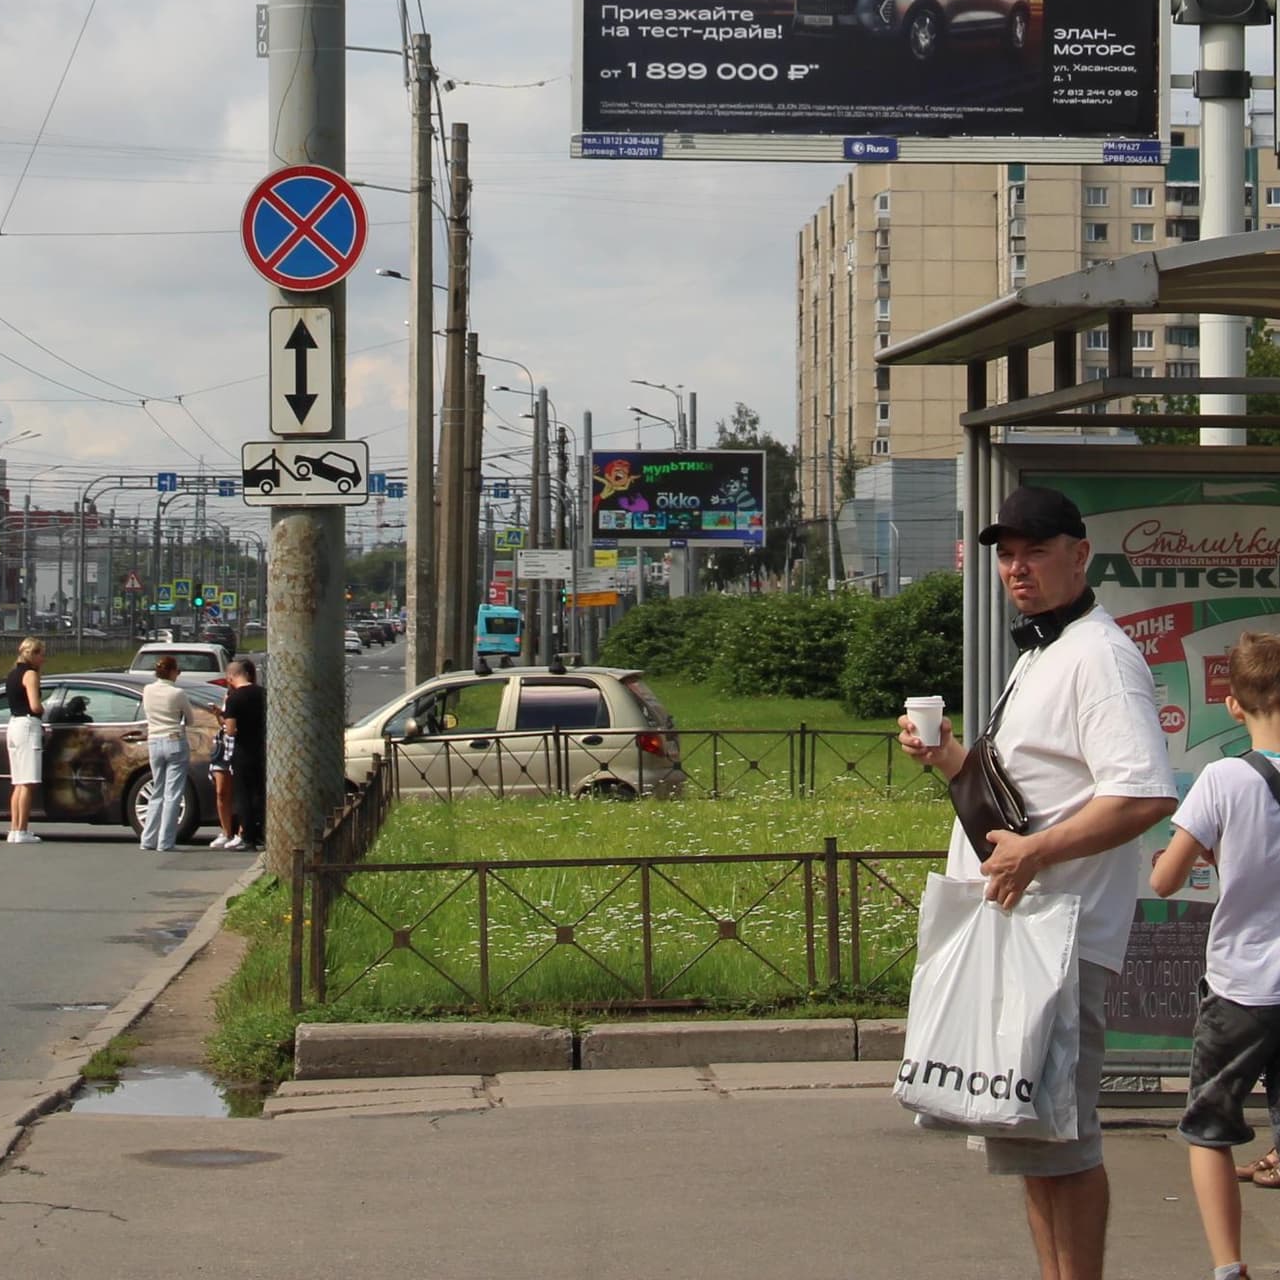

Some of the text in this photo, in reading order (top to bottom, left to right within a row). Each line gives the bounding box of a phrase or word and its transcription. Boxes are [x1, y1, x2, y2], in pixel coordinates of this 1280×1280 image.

[601, 5, 754, 22] Приезжайте
[601, 24, 783, 41] на тест-драйв!
[1053, 28, 1117, 40] ЭЛАН-
[1053, 44, 1136, 56] МОТОРС
[600, 69, 622, 79] от
[627, 62, 638, 79] 1
[646, 63, 708, 80] 899
[717, 63, 779, 80] 000
[1053, 65, 1070, 73] ул.
[866, 144, 889, 153] Russ
[1131, 557, 1158, 566] сеть
[1160, 557, 1238, 567] социальных
[1123, 613, 1175, 640] ОЛНЕ
[1104, 991, 1129, 1018] НИЕ
[897, 1058, 1034, 1103] amoda
